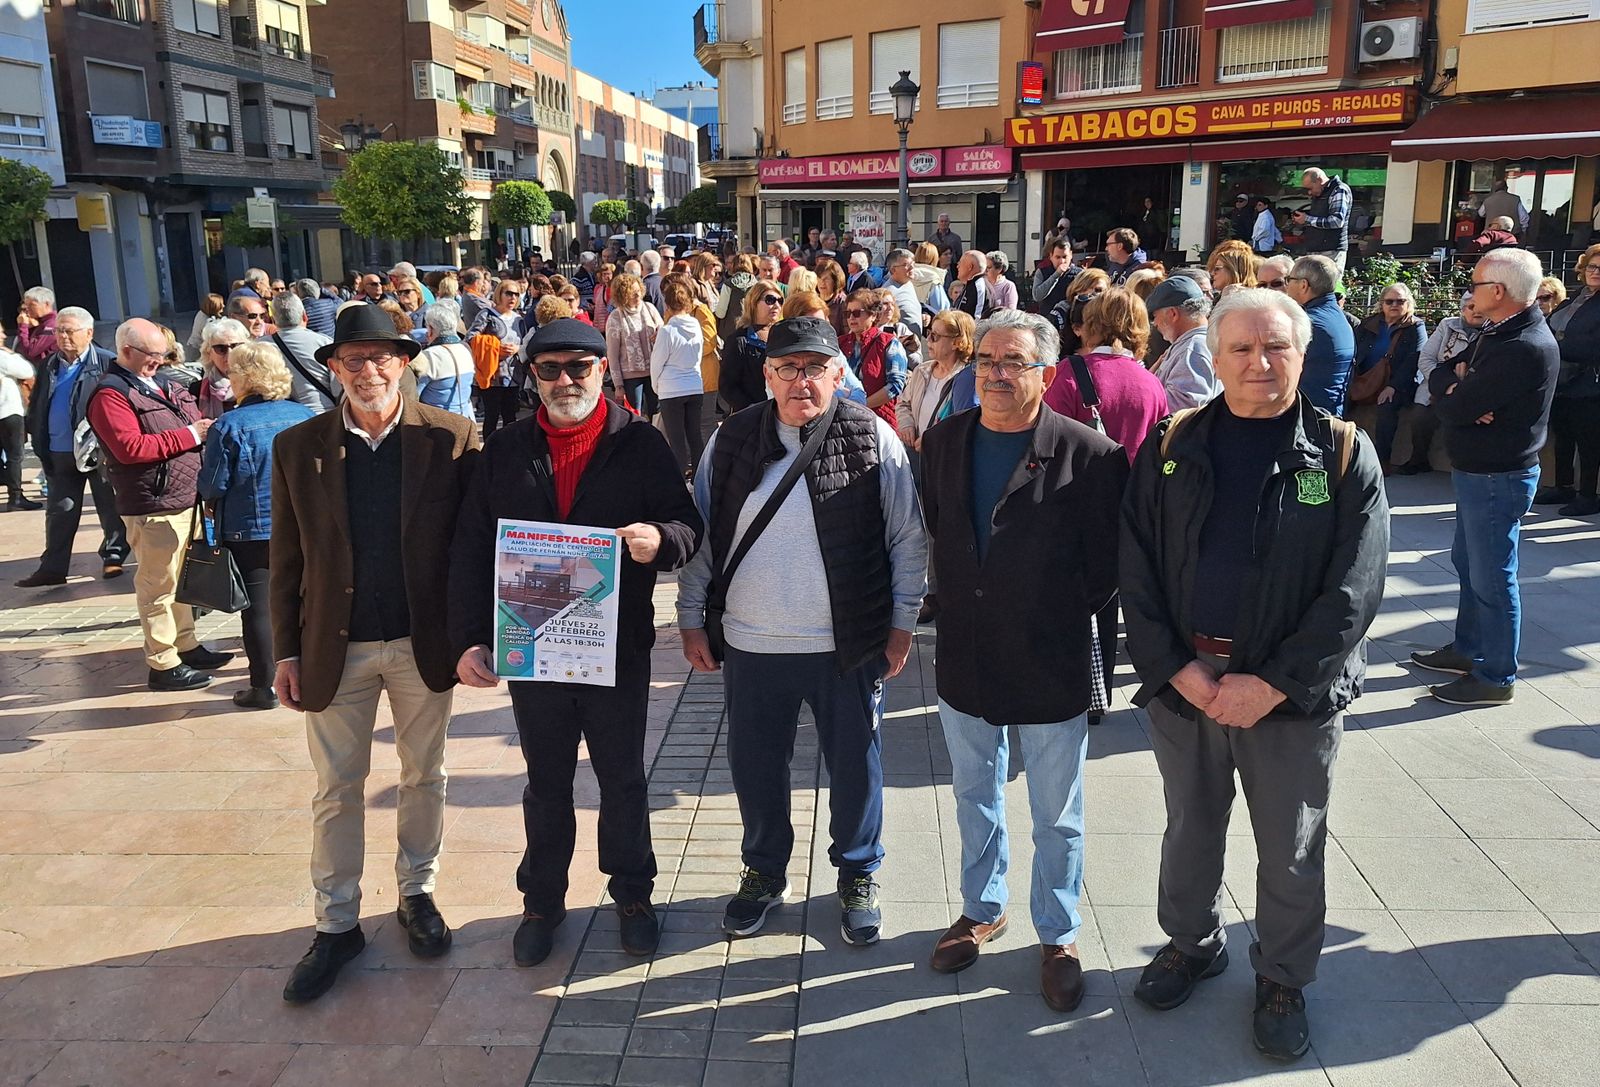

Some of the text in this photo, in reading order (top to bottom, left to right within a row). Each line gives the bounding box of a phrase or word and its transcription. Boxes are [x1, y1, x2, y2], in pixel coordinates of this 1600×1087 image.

[1211, 105, 1246, 120] CAVA
[1252, 102, 1270, 117] DE
[1273, 98, 1321, 115] PUROS
[1332, 92, 1402, 111] REGALOS
[1041, 105, 1197, 143] TABACOS
[1305, 118, 1324, 126] EXP.
[1335, 116, 1352, 124] 002
[963, 149, 994, 161] SALÓN
[808, 161, 827, 177] EL
[955, 160, 1001, 172] DE JUEGO
[506, 531, 611, 546] MANIFESTACIÓN
[511, 539, 552, 548] AMPLIACIÓN
[566, 544, 593, 552] CENTRO
[540, 547, 566, 555] FERNÁN
[549, 619, 586, 628] JUEVES
[560, 627, 606, 637] FEBRERO
[574, 639, 605, 648] 18:30H
